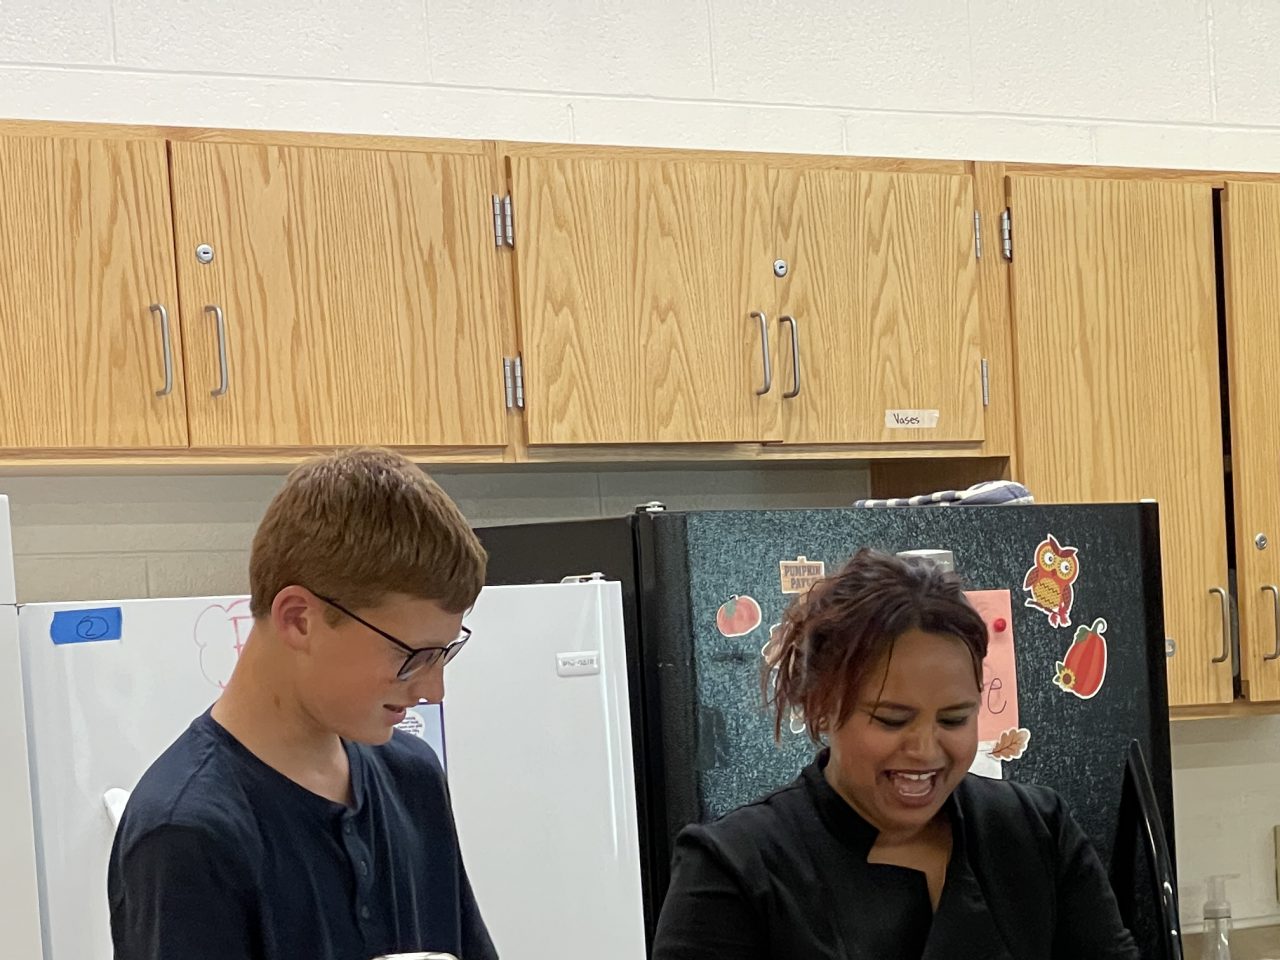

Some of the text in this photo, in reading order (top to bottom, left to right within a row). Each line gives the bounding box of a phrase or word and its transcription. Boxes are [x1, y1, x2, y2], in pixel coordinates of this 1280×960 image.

[893, 413, 920, 425] Vases
[784, 565, 821, 577] PUMPKIN
[790, 577, 815, 589] PATC
